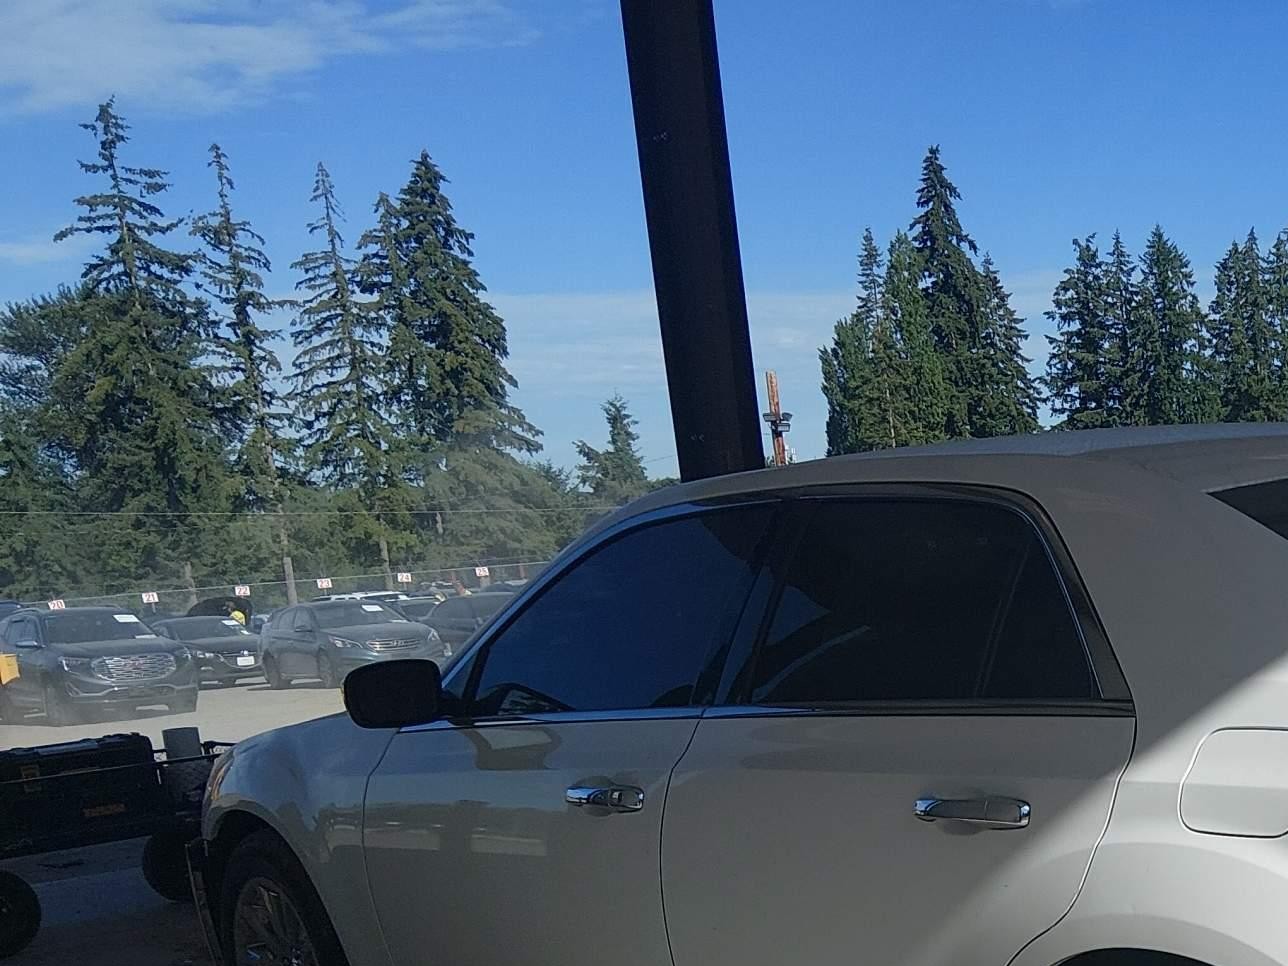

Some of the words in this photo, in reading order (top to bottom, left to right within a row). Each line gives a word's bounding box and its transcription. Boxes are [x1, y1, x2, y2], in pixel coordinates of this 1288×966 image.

[477, 567, 489, 577] 25
[398, 572, 411, 583] 24
[317, 578, 330, 588] 23
[236, 586, 249, 595] 22
[143, 592, 157, 602] 21
[50, 599, 64, 610] 20
